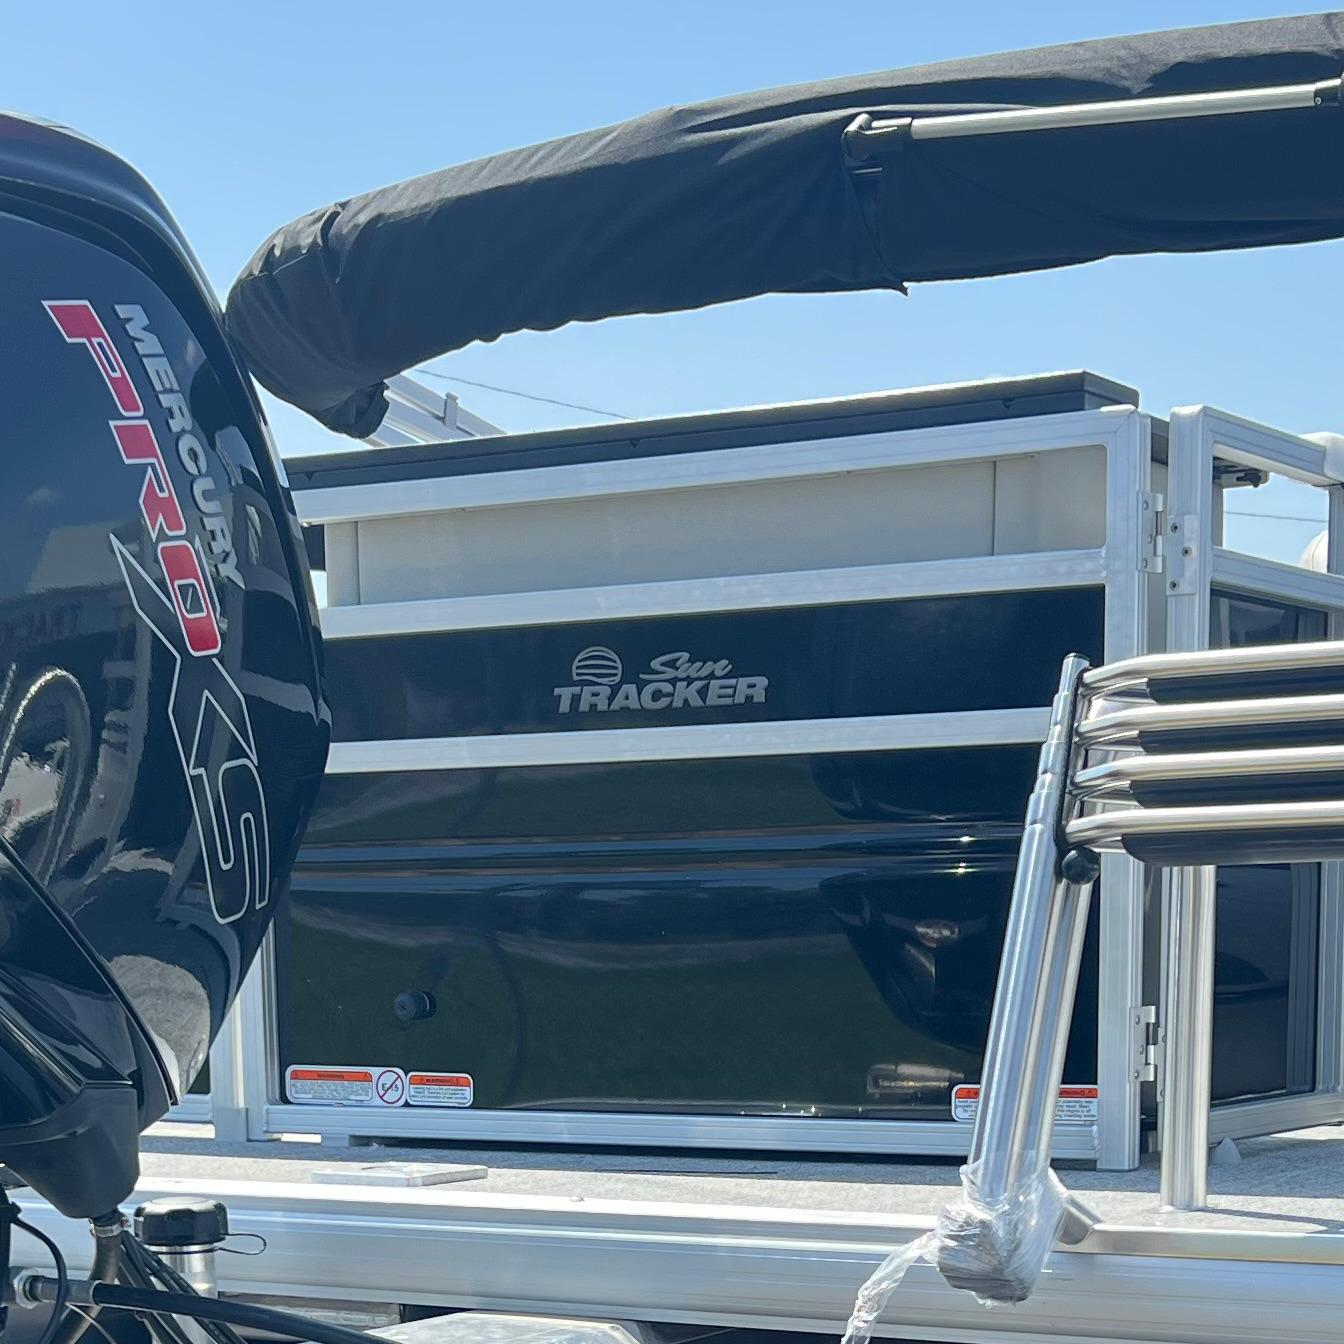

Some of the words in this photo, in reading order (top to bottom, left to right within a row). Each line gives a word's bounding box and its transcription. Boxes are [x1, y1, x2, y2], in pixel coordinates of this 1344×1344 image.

[40, 299, 221, 657] PRO
[115, 303, 245, 591] MERCURY
[553, 675, 769, 714] TRACKER
[638, 651, 733, 681] Sun
